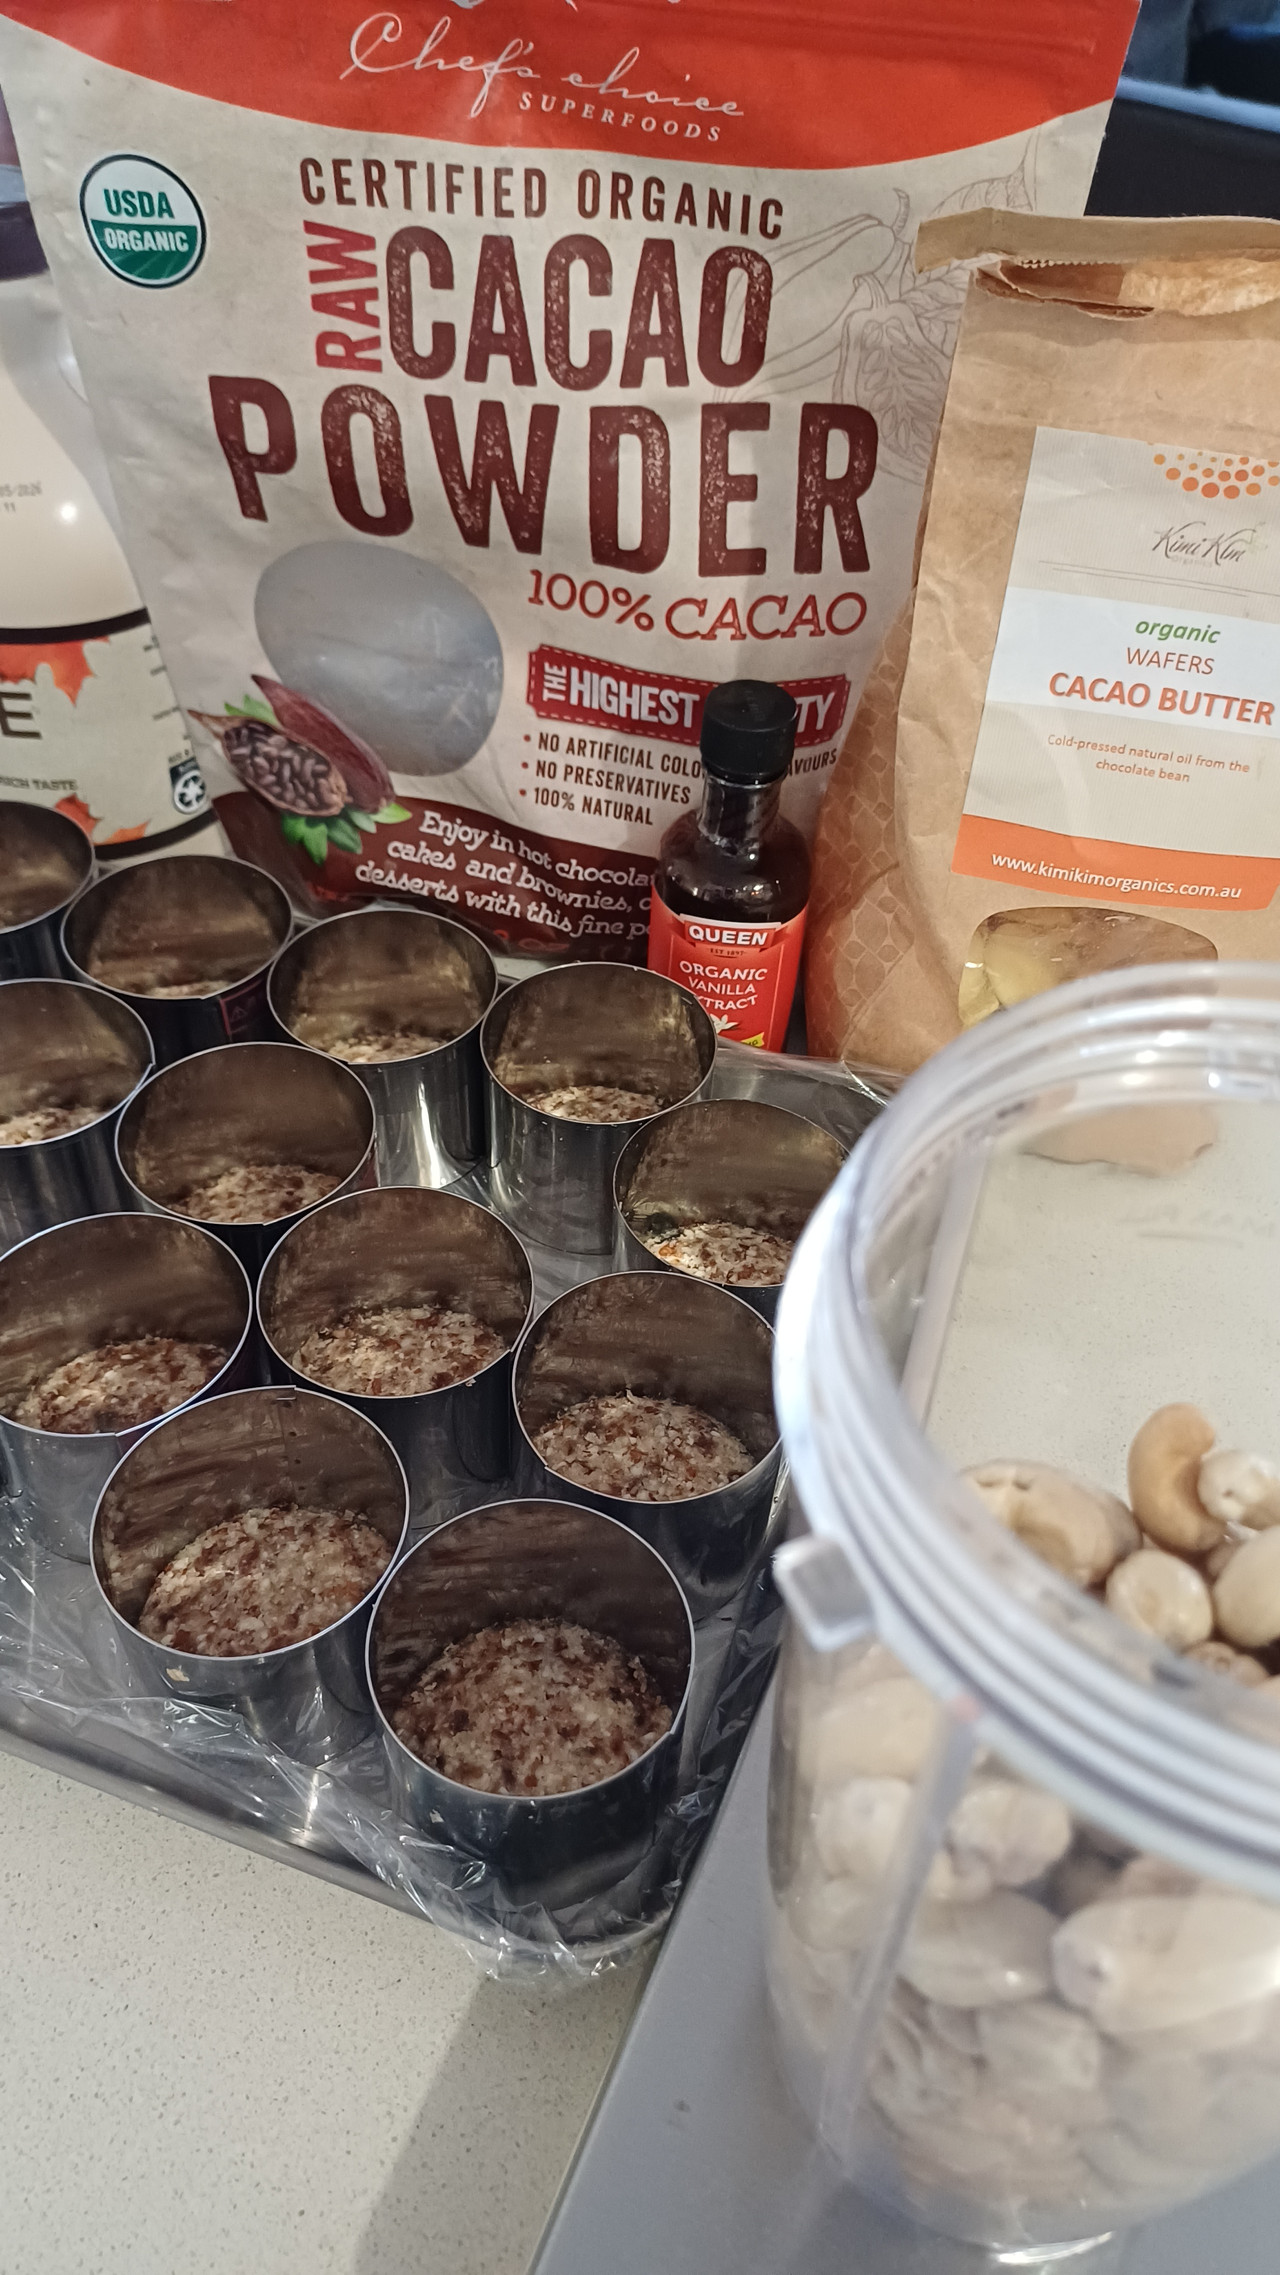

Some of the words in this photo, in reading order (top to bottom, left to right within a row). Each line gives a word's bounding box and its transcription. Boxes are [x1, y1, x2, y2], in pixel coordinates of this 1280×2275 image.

[340, 12, 541, 118] Chef's
[561, 46, 744, 116] choice
[519, 91, 721, 142] SUPERFOODS
[103, 187, 175, 220] USDA
[301, 157, 547, 219] CERTIFIED
[577, 169, 783, 240] ORGANIC
[104, 227, 190, 254] ORGANIC
[303, 220, 383, 373] RAW
[386, 226, 773, 391] CACAO
[208, 375, 879, 577] POWDER
[527, 569, 654, 632] 100%
[664, 591, 867, 641] CACAO
[1135, 620, 1221, 644] organic
[542, 661, 567, 702] THE
[1127, 647, 1215, 675] WAFERS
[569, 666, 700, 729] HIGHEST
[1049, 672, 1151, 708] CACAO
[1158, 687, 1275, 726] BUTTER
[538, 732, 560, 752] NO
[565, 737, 654, 770] ARTIFICIAL
[660, 753, 705, 779] COLO
[1048, 734, 1127, 756] Cold-pressed
[1128, 748, 1173, 763] natural
[1176, 752, 1193, 765] oil
[1195, 754, 1225, 770] from
[1229, 761, 1250, 773] the
[1095, 760, 1155, 778] chocolate
[1158, 768, 1190, 783] bean
[536, 760, 557, 779] NO
[563, 764, 691, 805] PRESERVATIVES
[534, 787, 575, 811] 100%
[581, 796, 653, 825] NATURAL
[419, 811, 489, 851] Enjoy
[490, 830, 515, 853] in
[518, 840, 553, 870] hot
[355, 860, 459, 903] desserts
[465, 889, 522, 918] with
[526, 901, 573, 933] this
[569, 914, 623, 938] fine
[387, 840, 457, 870] cakes
[465, 859, 517, 886] and
[516, 863, 632, 912] brownies,
[991, 853, 1242, 899] www.kimikimorganics.com.au
[688, 925, 768, 946] QUEEN
[679, 960, 768, 981] ORGANIC
[688, 975, 756, 995] VANILLA
